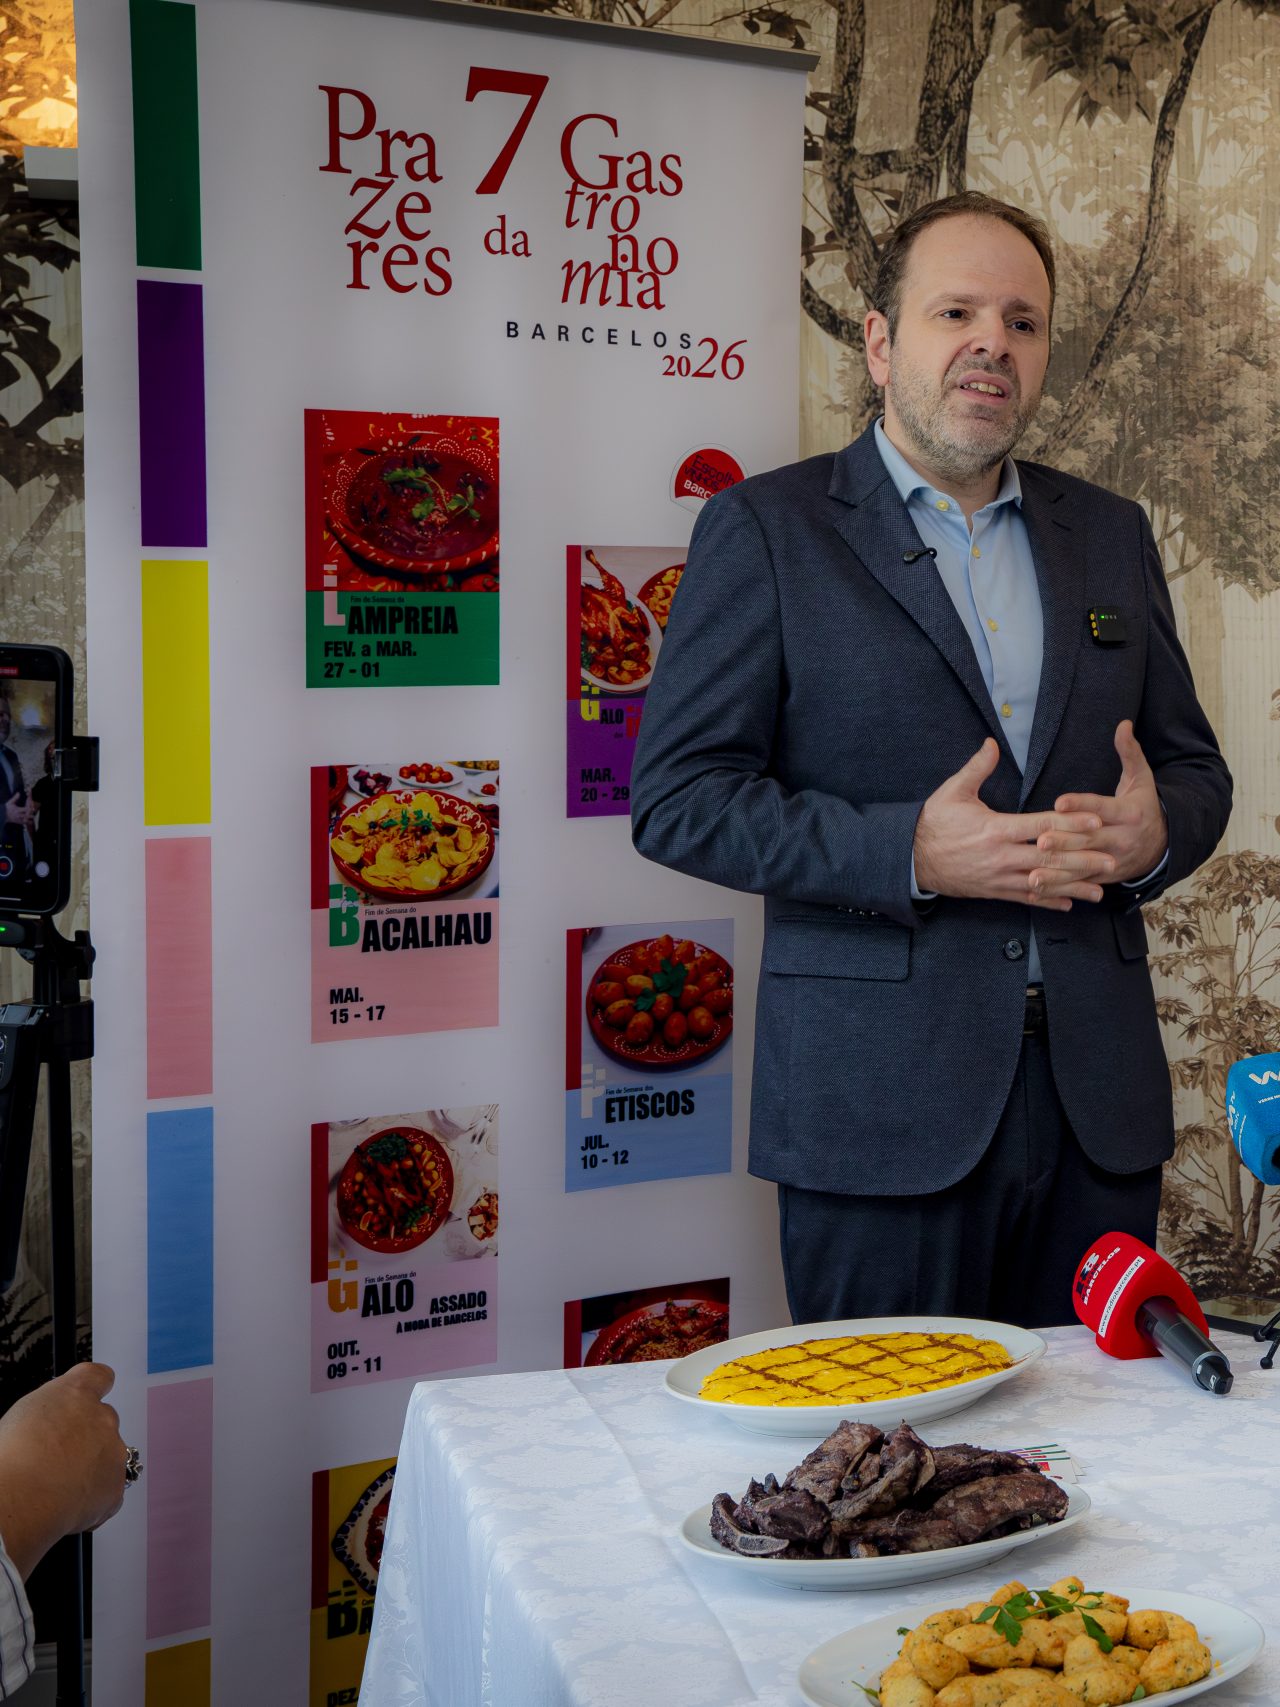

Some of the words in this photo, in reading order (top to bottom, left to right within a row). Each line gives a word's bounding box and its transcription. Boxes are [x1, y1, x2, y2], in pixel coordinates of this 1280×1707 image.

[318, 85, 443, 183] Pra
[465, 66, 549, 195] 7
[560, 113, 684, 196] Gas
[344, 177, 432, 241] ze
[484, 215, 532, 257] da
[346, 240, 453, 296] res
[506, 321, 692, 349] BARCELOS
[662, 337, 748, 380] 2026
[692, 454, 735, 487] Escolh
[324, 641, 356, 657] FEV.
[361, 643, 371, 657] a
[376, 641, 417, 657] MAR.
[324, 662, 345, 678] 27
[361, 662, 380, 678] 01
[581, 768, 616, 783] MAR.
[581, 787, 598, 802] 20
[612, 786, 630, 801] 29
[385, 907, 408, 915] Semana
[330, 987, 364, 1005] MAI.
[330, 1008, 349, 1024] 15
[366, 1005, 386, 1021] 17
[623, 1086, 643, 1094] Semana
[581, 1134, 609, 1151] JUL.
[581, 1154, 598, 1169] 10
[612, 1149, 629, 1165] 12
[364, 1276, 376, 1284] Fim
[377, 1275, 385, 1283] de
[385, 1273, 408, 1281] Semana
[1083, 1246, 1121, 1306] BARCELOS
[429, 1290, 487, 1315] ASSADO
[404, 1318, 430, 1332] MODA
[431, 1316, 442, 1328] DE
[443, 1309, 488, 1326] BARCELOS
[327, 1340, 360, 1359] OUT.
[327, 1362, 347, 1379] 09
[364, 1356, 381, 1373] 11
